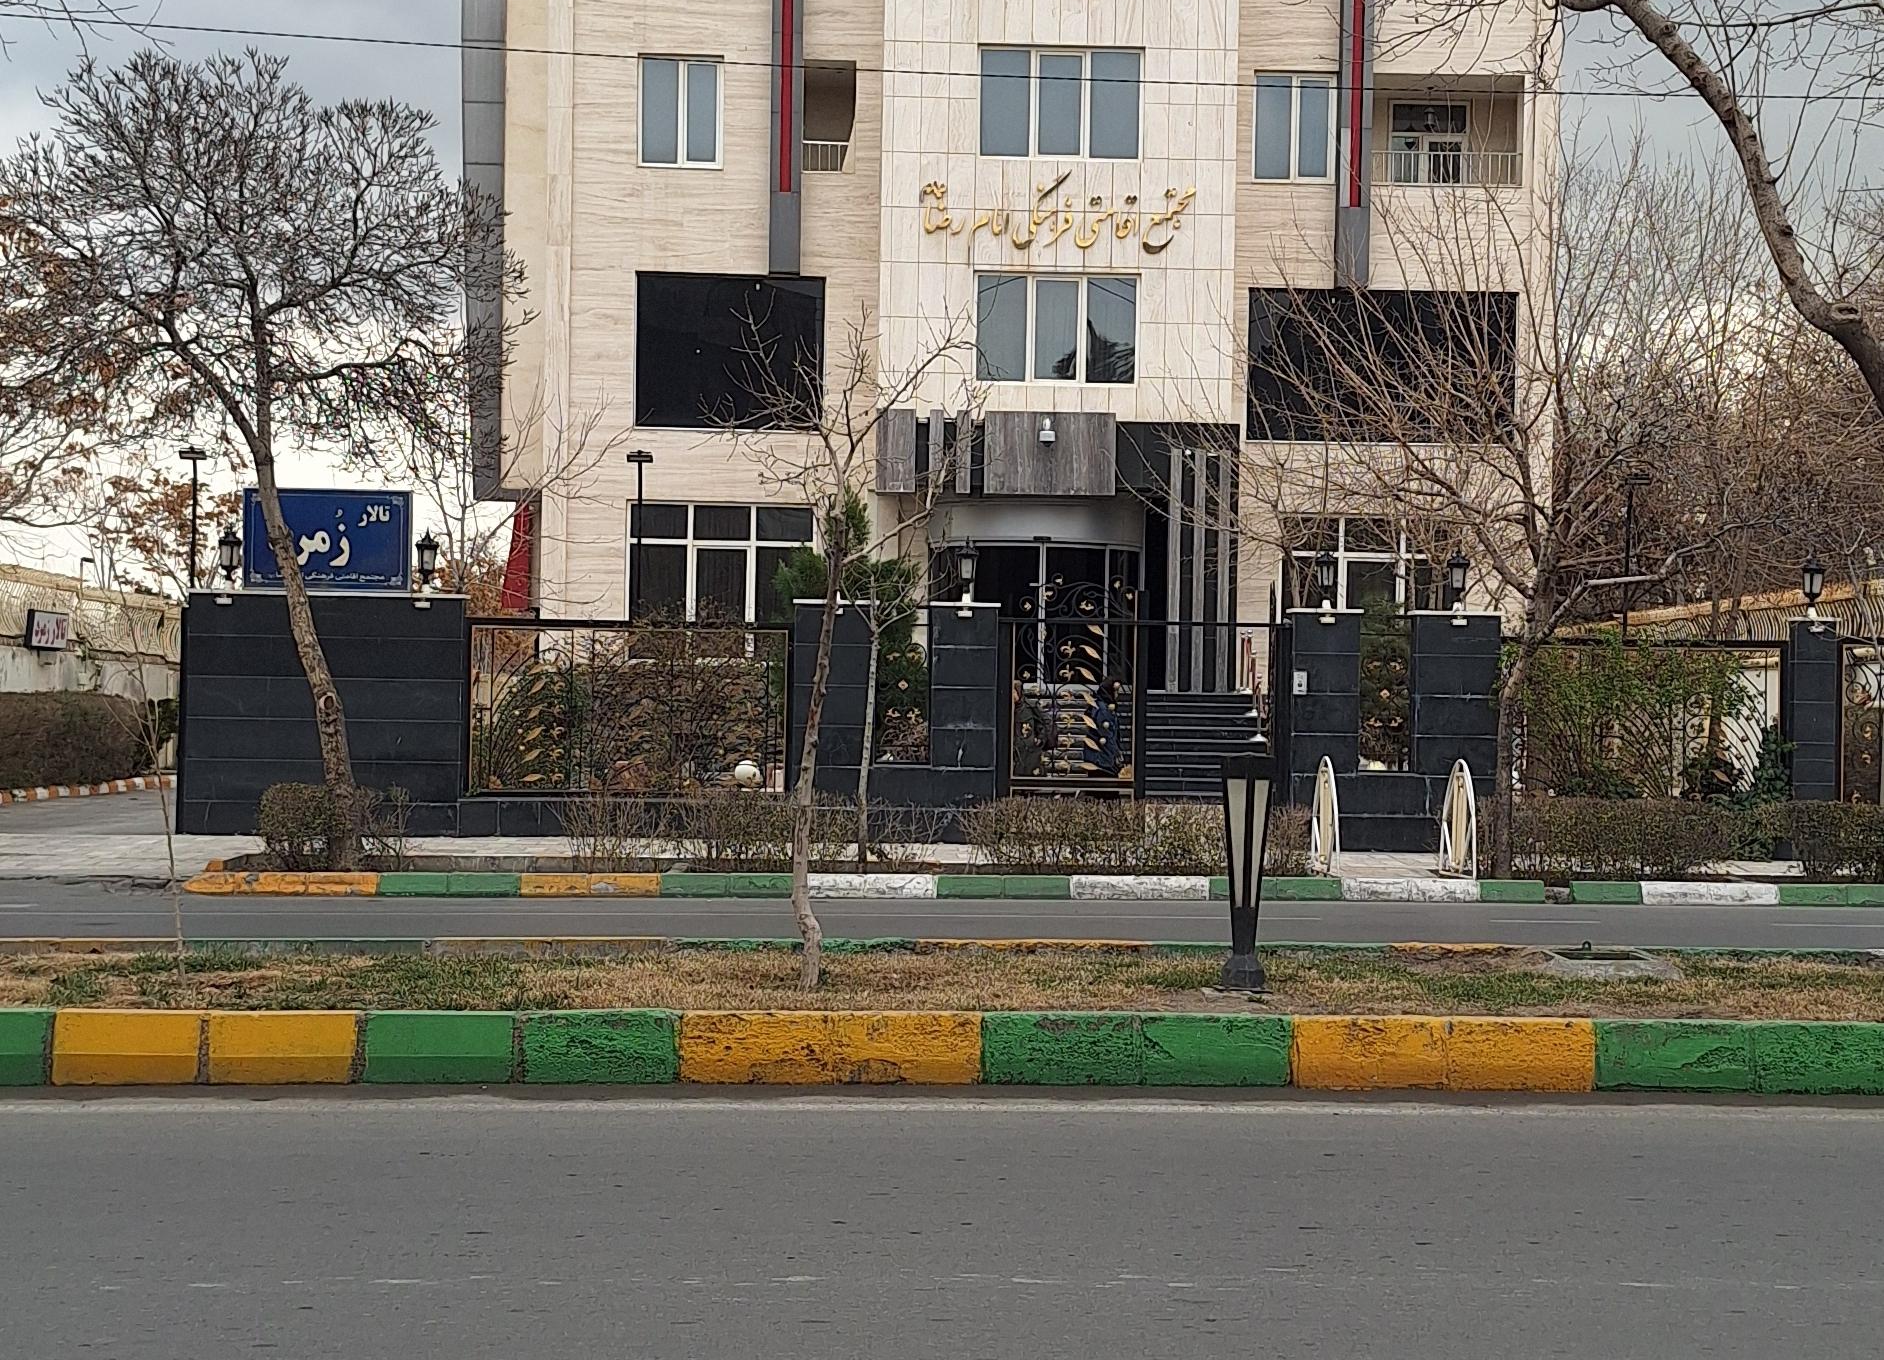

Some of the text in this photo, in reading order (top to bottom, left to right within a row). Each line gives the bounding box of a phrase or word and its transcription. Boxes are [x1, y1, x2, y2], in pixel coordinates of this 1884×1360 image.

[924, 168, 1196, 269] مجتمع اقامتی فرهنگی امام رضا
[357, 504, 391, 527] تالار
[269, 508, 351, 567] زُمر
[304, 571, 334, 581] فرهنگی
[358, 573, 386, 583] مجتمع
[51, 616, 67, 645] تالار
